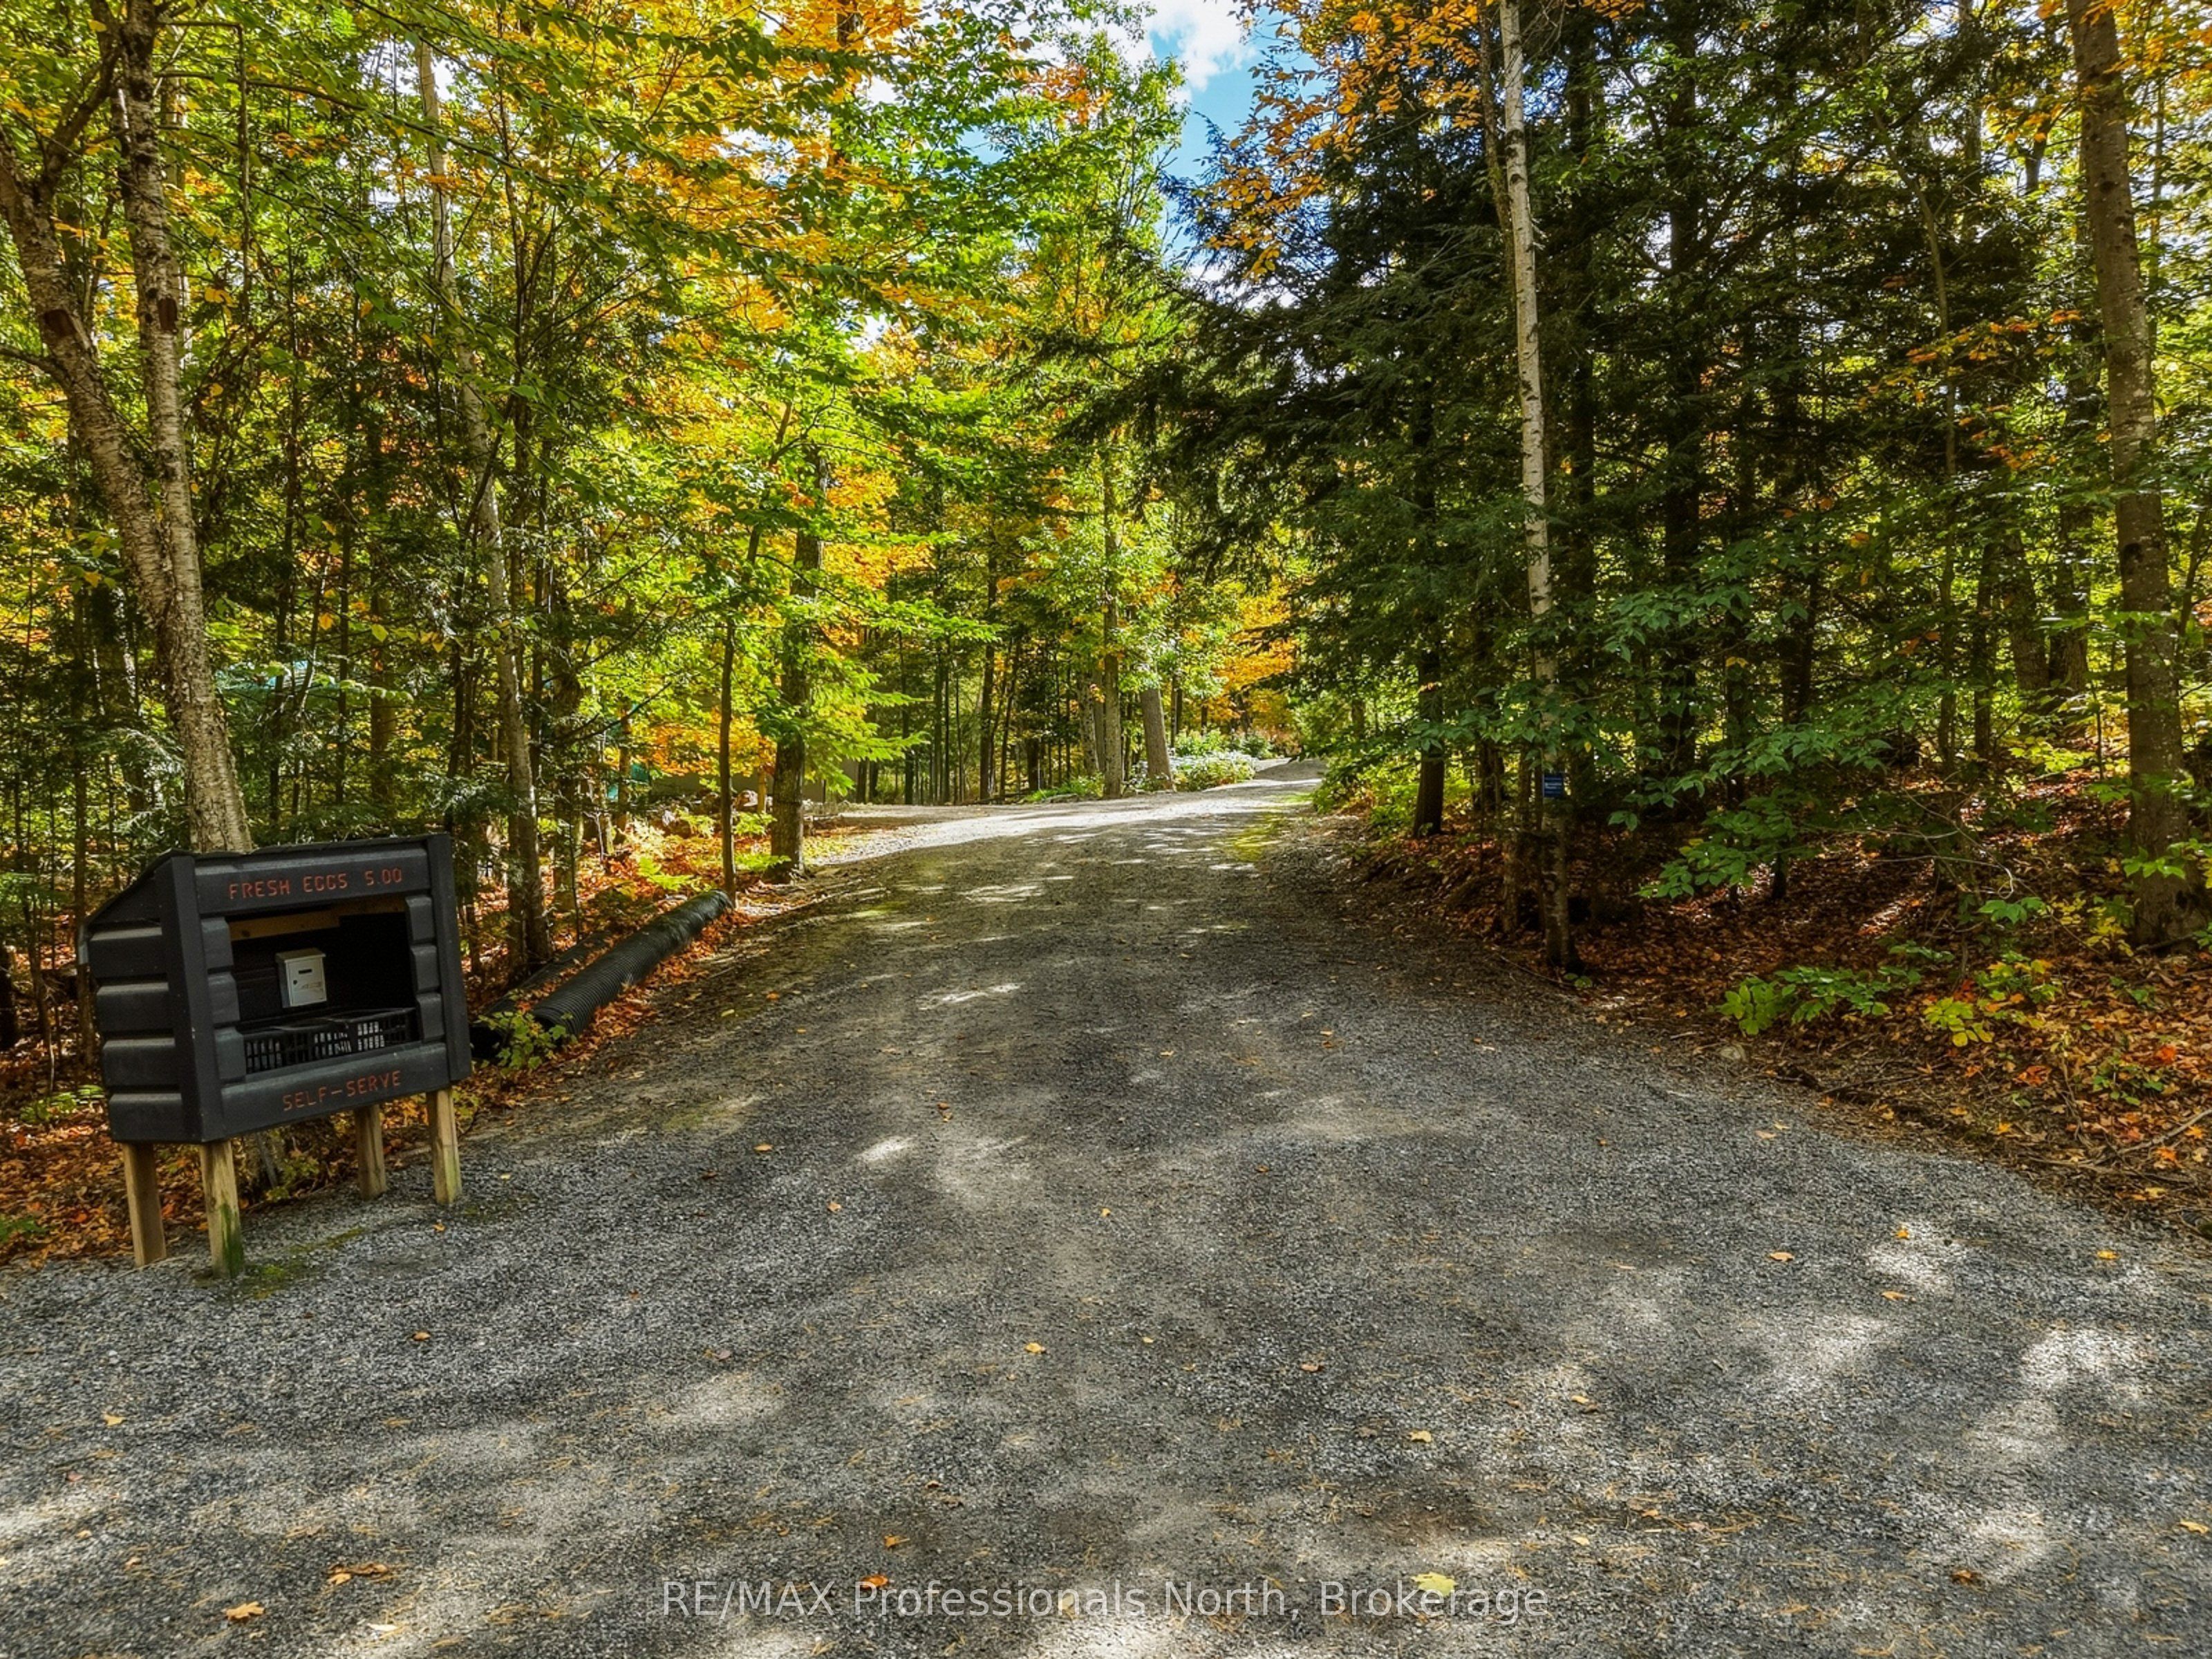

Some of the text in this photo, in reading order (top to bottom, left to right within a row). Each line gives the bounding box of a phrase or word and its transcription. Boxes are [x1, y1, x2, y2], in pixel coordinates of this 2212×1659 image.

[229, 868, 402, 899] FRESH EGGS 5.00
[282, 1070, 401, 1112] SELF-SERVE
